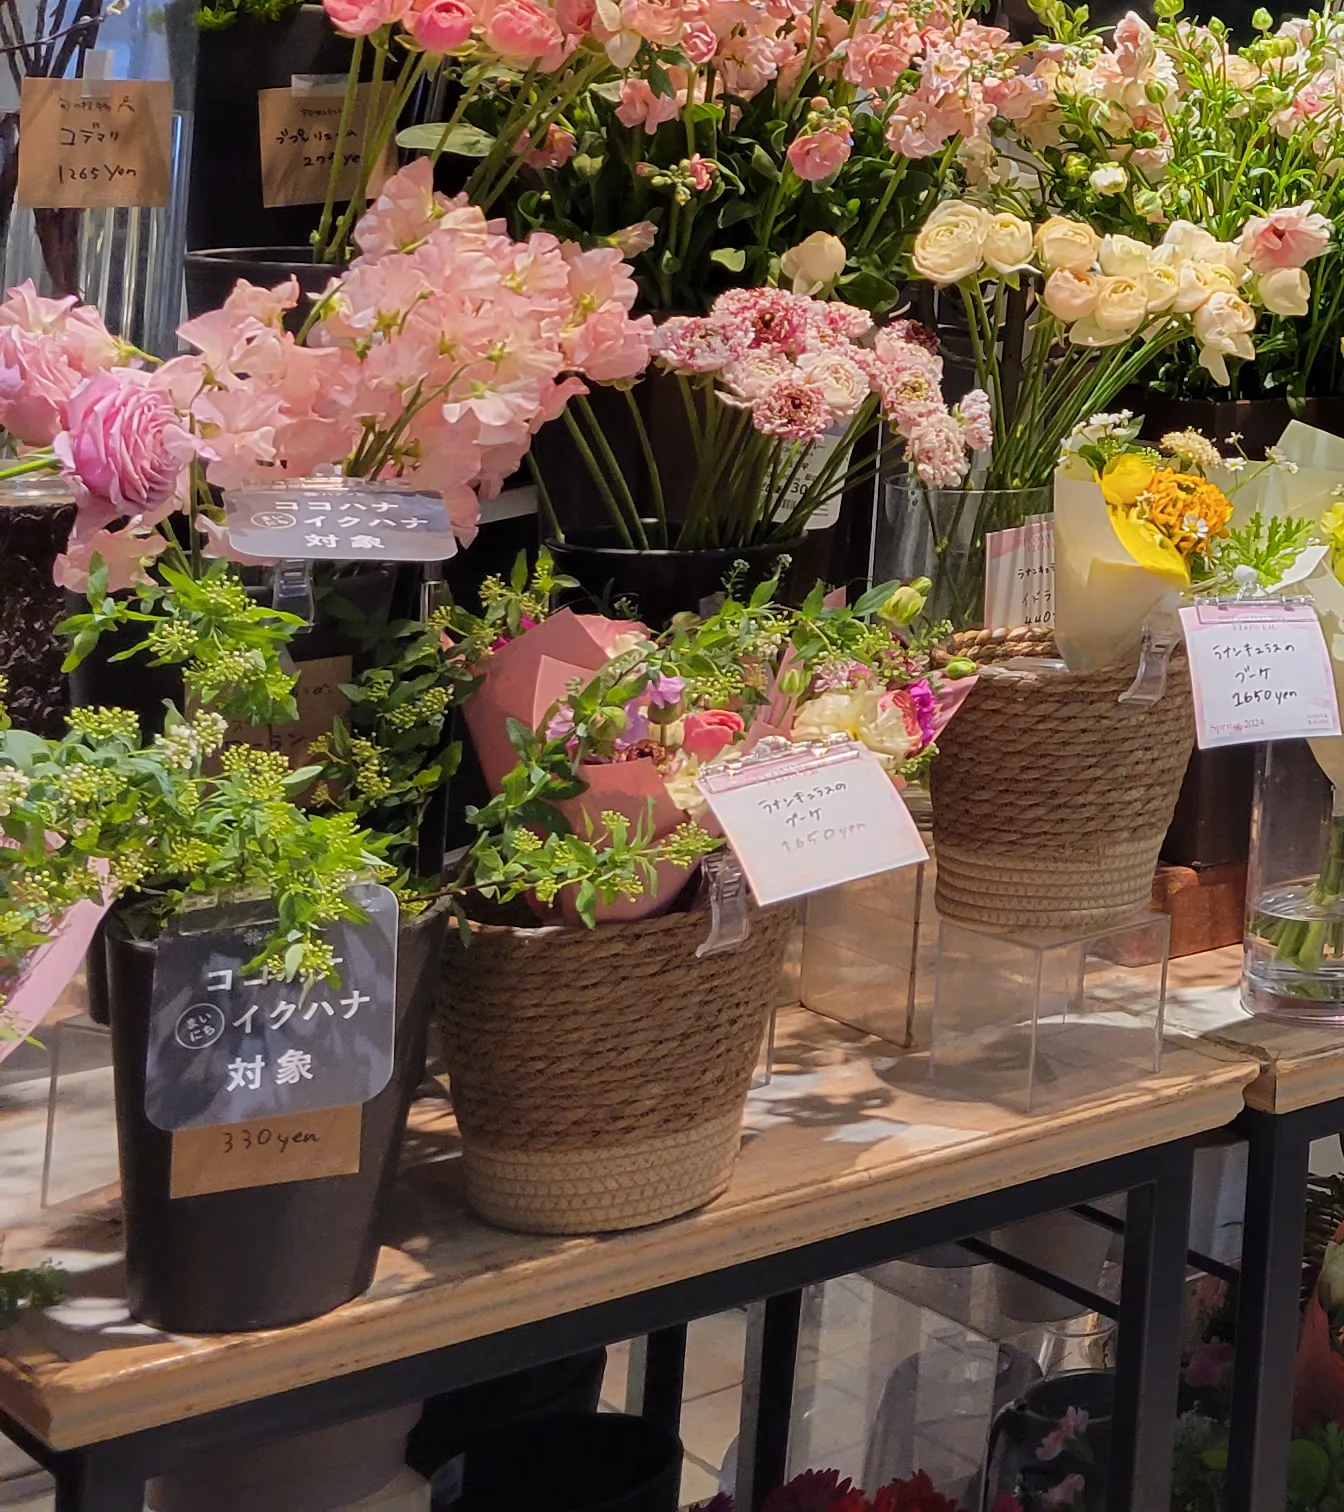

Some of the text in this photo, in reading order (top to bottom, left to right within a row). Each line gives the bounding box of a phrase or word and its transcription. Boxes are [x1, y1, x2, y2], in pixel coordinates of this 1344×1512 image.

[60, 122, 119, 146] コデマリ
[275, 500, 400, 513] ココハナ
[304, 515, 429, 529] イクハナ
[305, 534, 386, 549] 対象
[1235, 665, 1272, 684] ブーケ
[231, 990, 371, 1034] イクハナ
[226, 1049, 314, 1092] 対象
